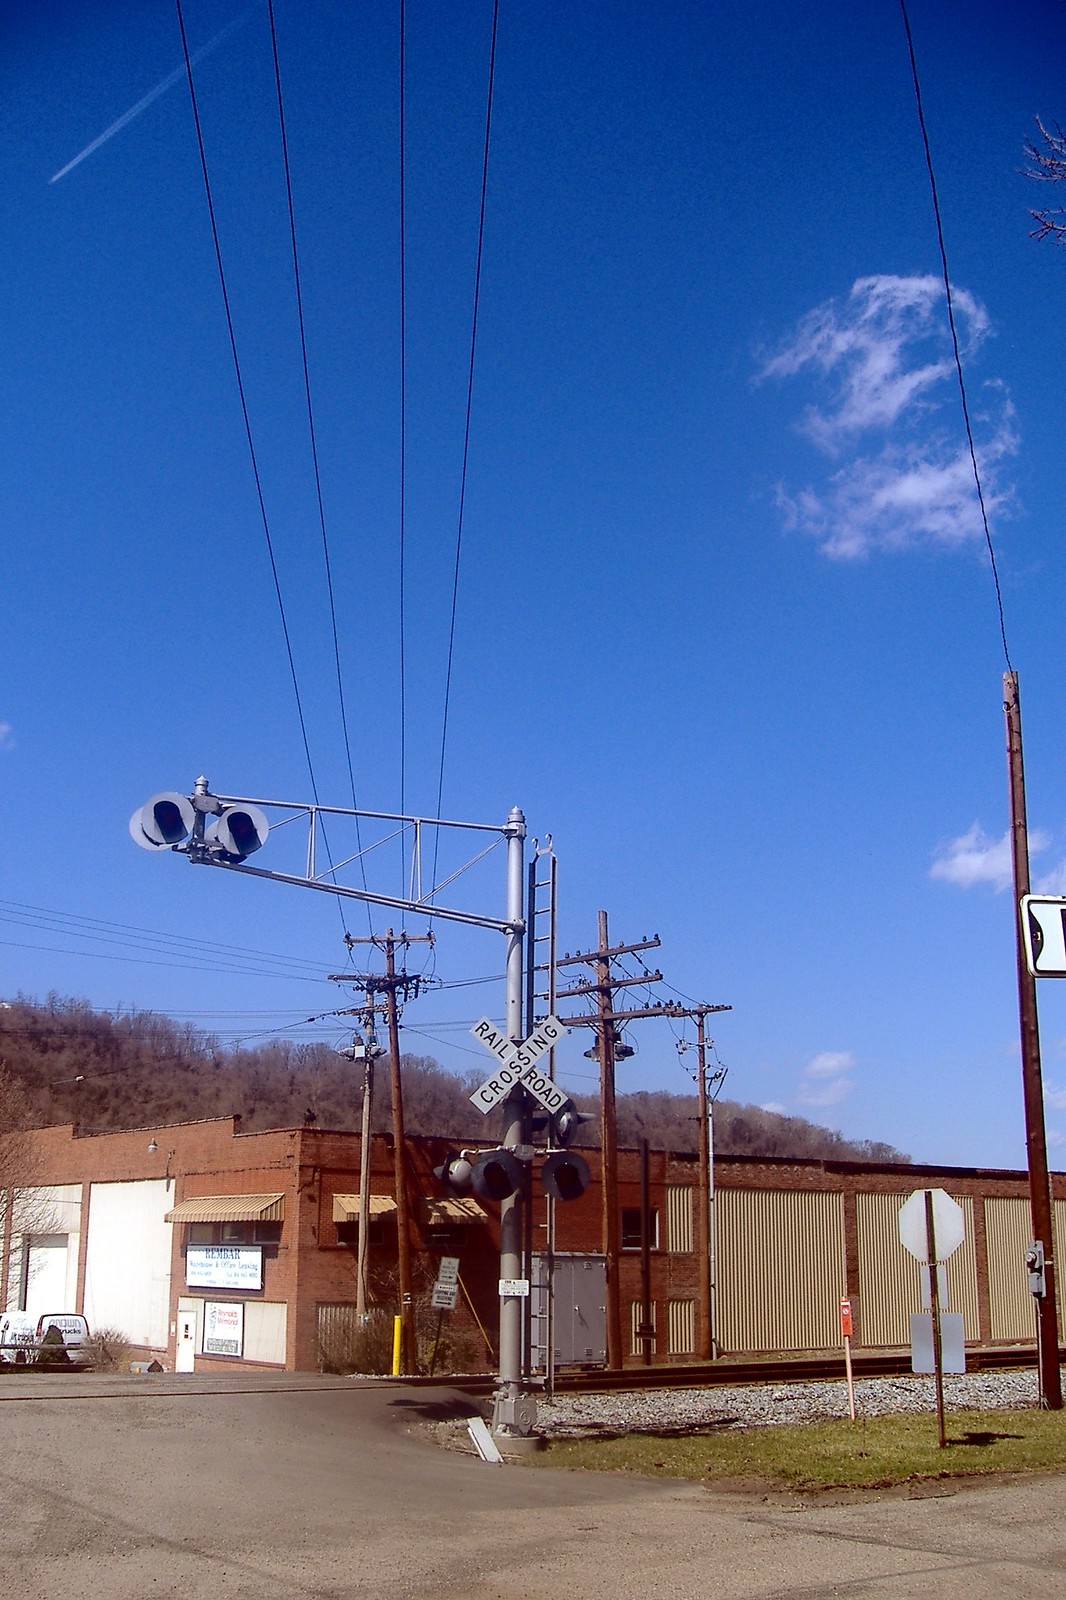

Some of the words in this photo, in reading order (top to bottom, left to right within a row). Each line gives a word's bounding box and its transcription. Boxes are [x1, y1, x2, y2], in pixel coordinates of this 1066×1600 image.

[475, 1021, 509, 1059] RAIL
[523, 1069, 562, 1108] ROAD
[480, 1025, 558, 1103] CROSSING
[205, 1247, 241, 1260] REMBAR
